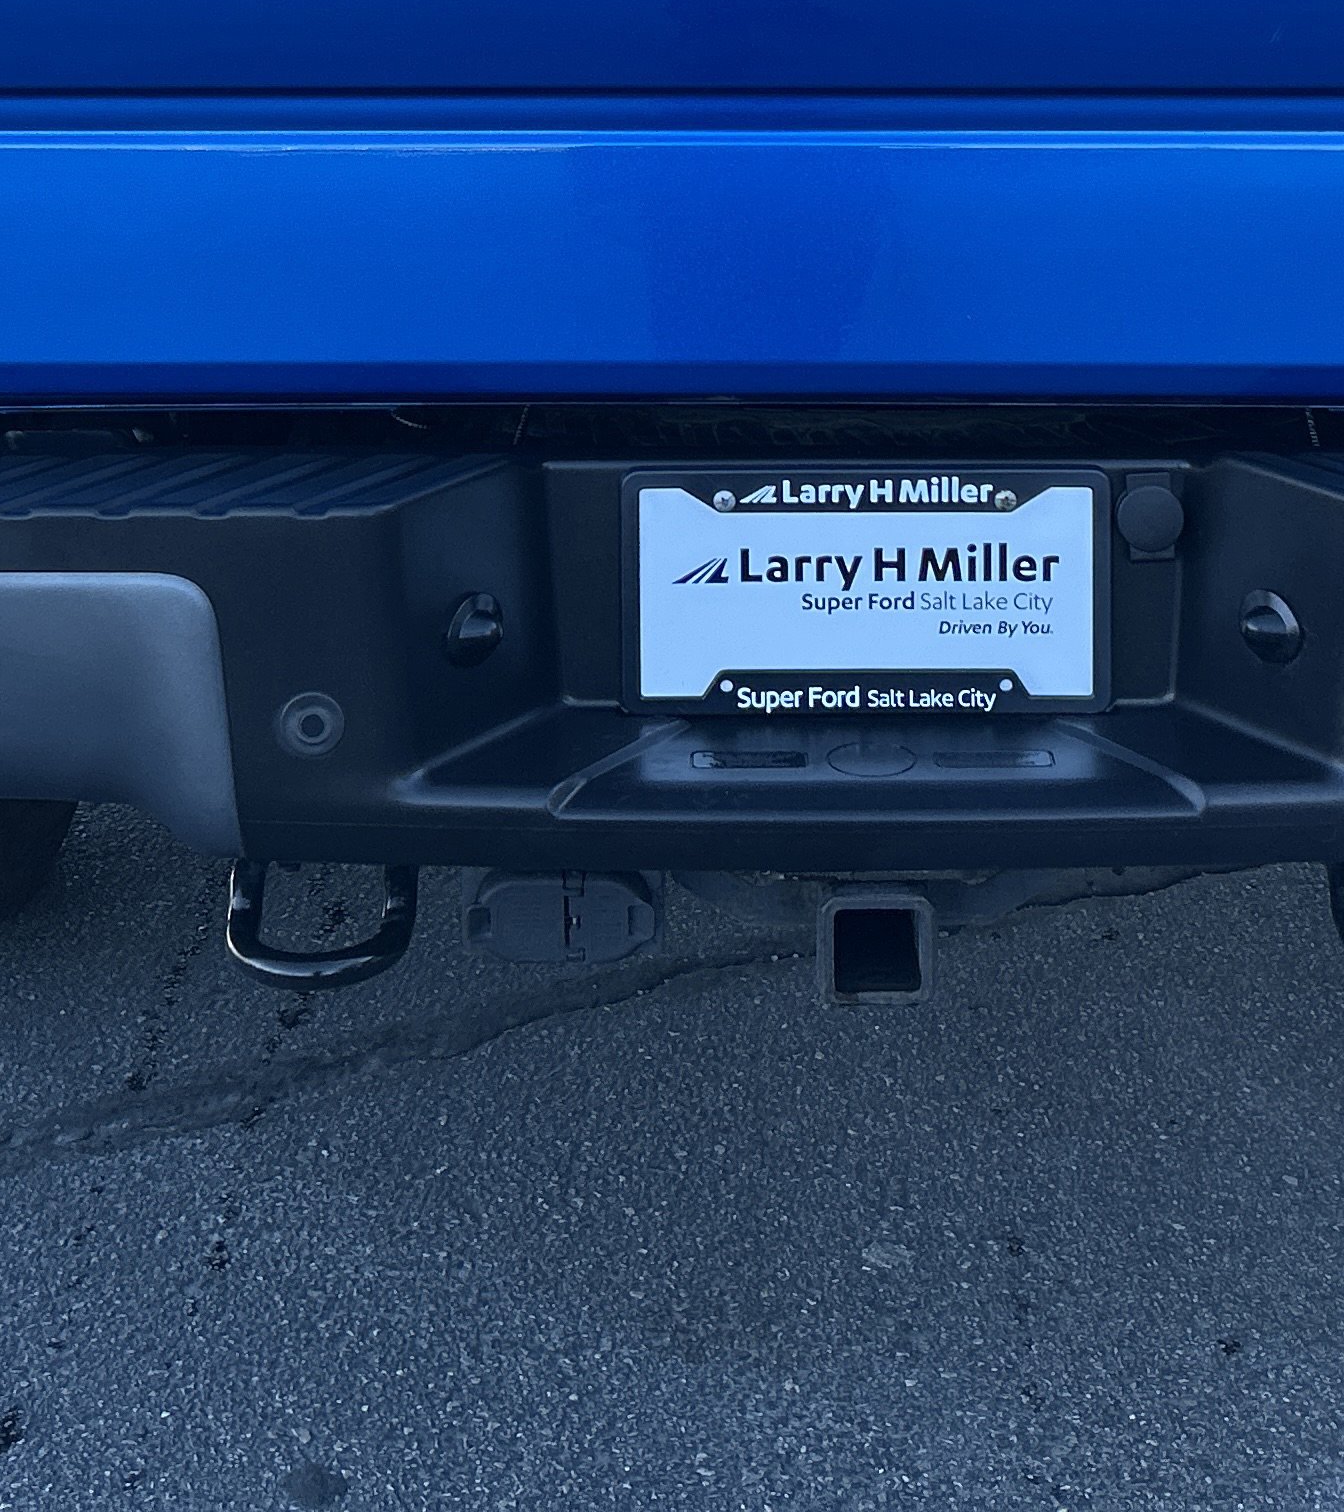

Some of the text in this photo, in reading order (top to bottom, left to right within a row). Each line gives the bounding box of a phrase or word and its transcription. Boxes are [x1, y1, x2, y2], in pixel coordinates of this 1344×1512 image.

[782, 476, 994, 509] Larry H Miller
[739, 543, 1060, 590] Larry H Miller
[801, 591, 1054, 615] Super Ford Salt Lake City
[939, 619, 992, 635] Driven
[997, 620, 1018, 638] By
[737, 685, 997, 714] Super Ford Salt Lake City
